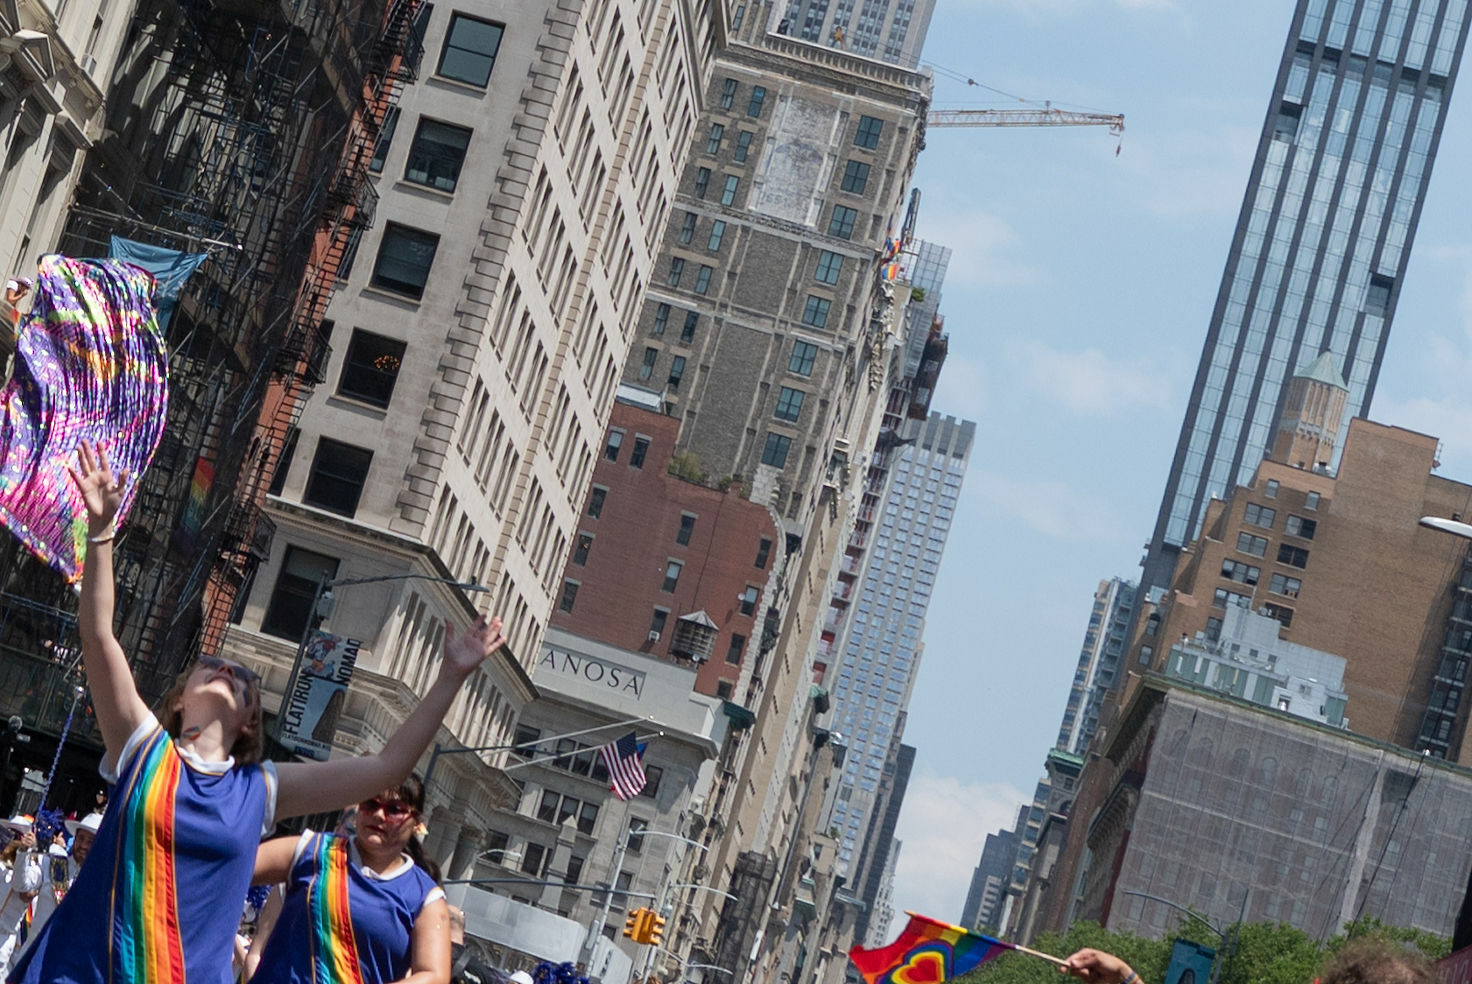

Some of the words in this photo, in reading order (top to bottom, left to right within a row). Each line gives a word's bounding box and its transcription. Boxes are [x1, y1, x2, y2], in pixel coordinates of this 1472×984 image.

[336, 638, 361, 687] NOMAD
[540, 649, 639, 695] ANOSA
[283, 670, 313, 735] FLATIRON
